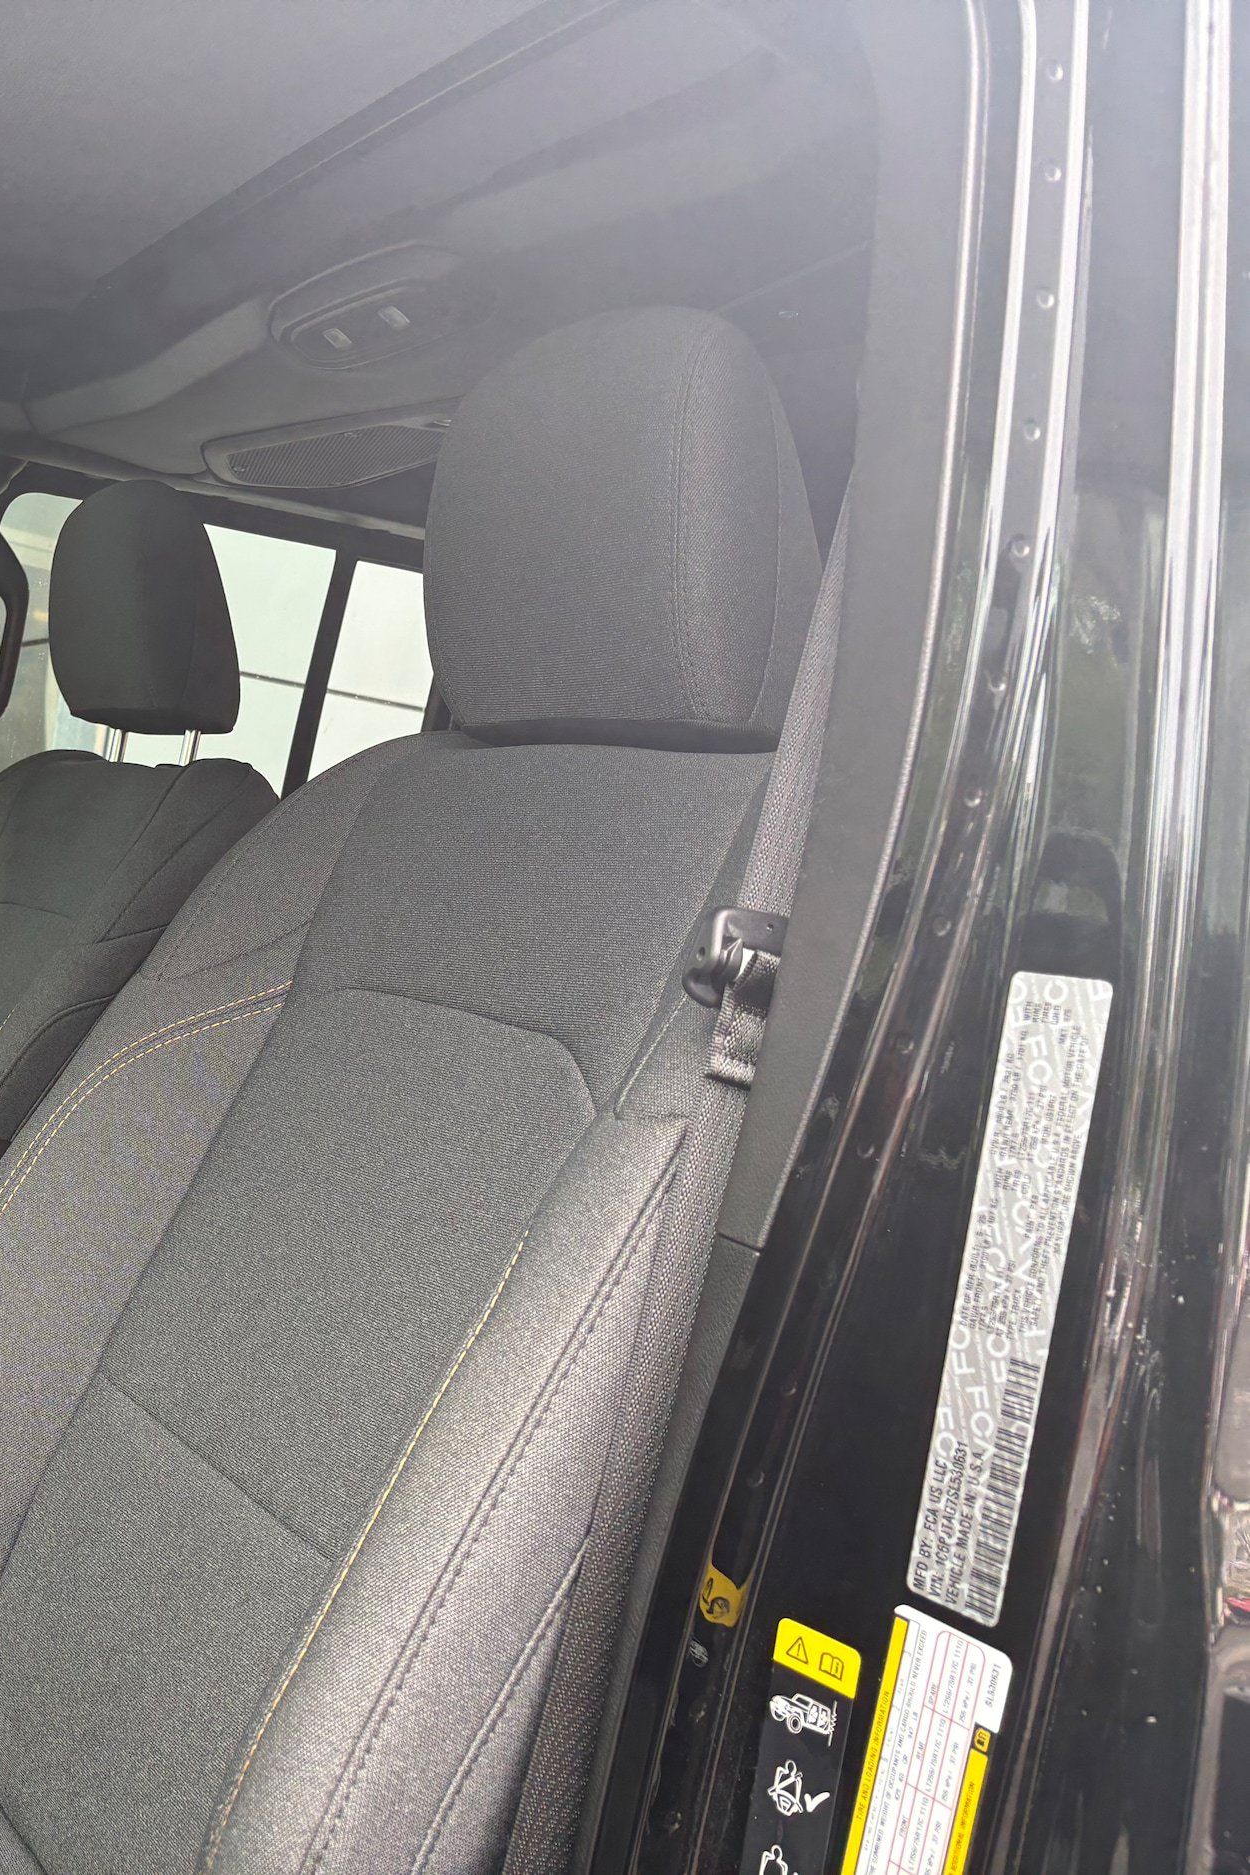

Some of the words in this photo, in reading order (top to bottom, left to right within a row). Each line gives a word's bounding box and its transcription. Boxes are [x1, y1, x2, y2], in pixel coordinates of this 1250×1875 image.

[931, 1458, 947, 1483] LLC
[927, 1484, 943, 1503] US
[922, 1506, 939, 1532] FCA
[954, 1510, 973, 1550] MADE
[918, 1535, 934, 1559] BY:
[912, 1559, 929, 1591] MFD
[928, 1570, 945, 1599] VIN:
[944, 1551, 966, 1606] VEHICLE
